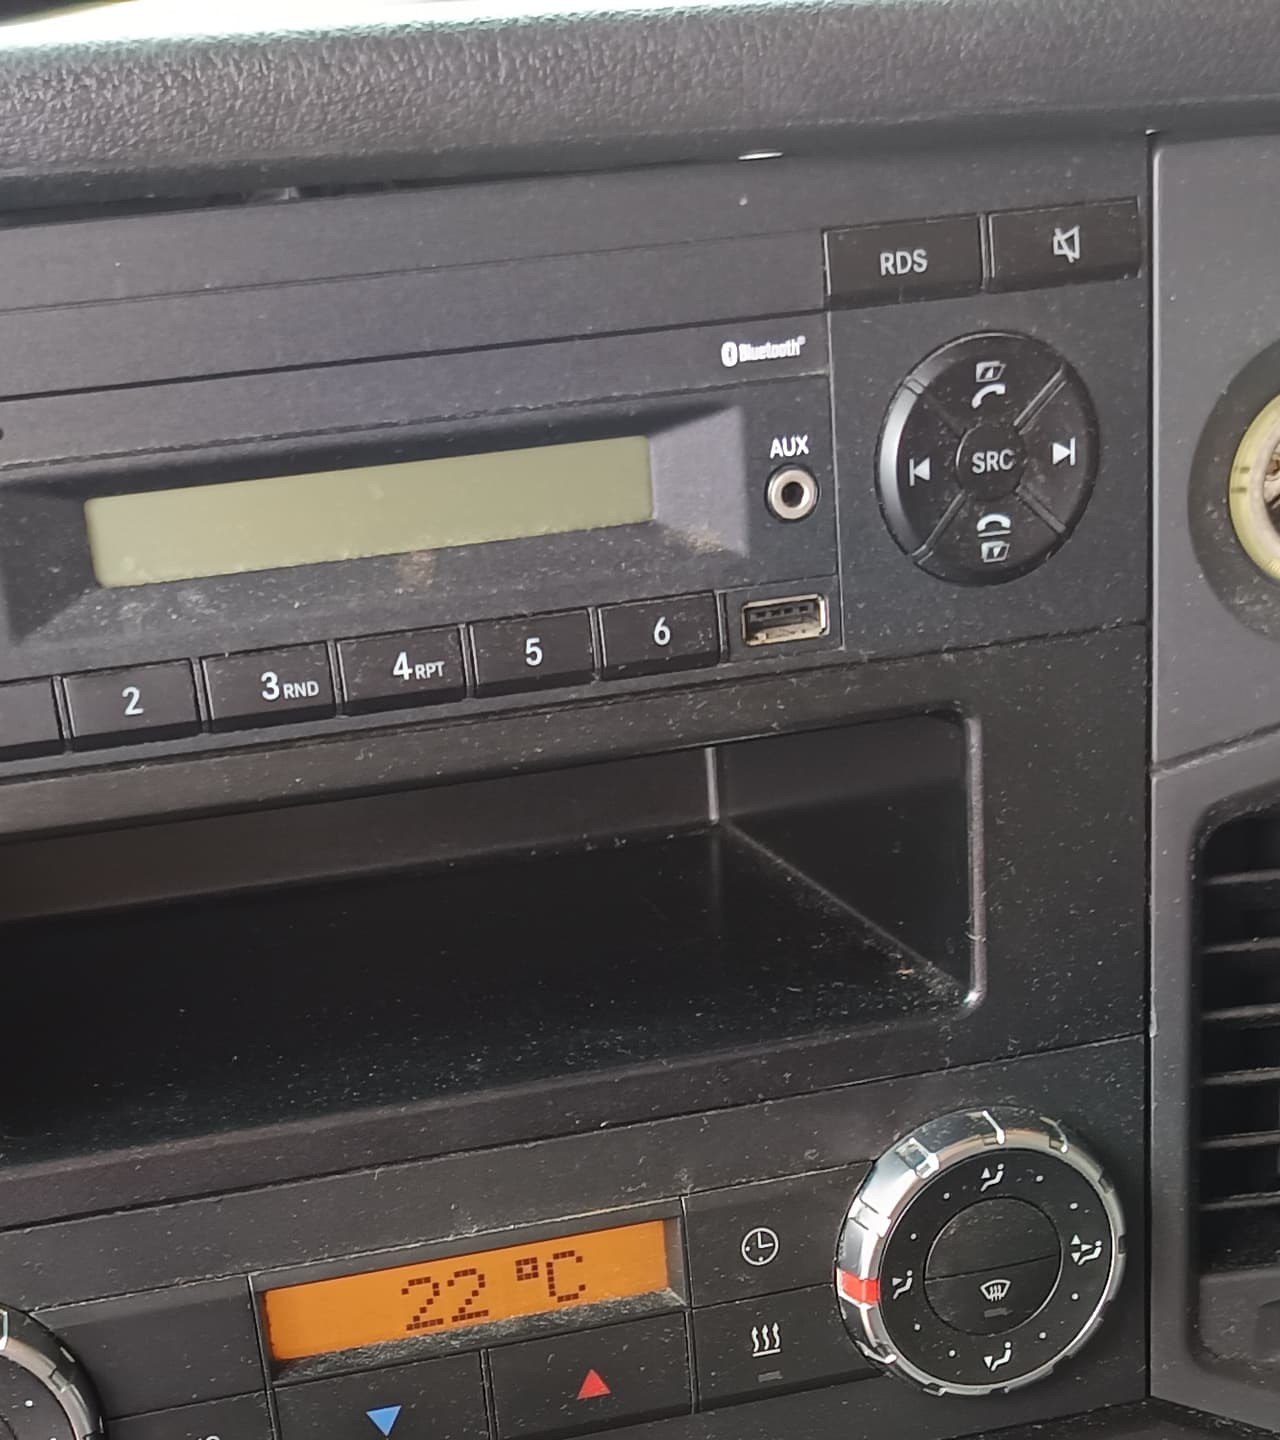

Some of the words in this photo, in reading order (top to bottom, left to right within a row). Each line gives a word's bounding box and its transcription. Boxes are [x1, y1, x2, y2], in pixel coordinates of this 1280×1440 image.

[880, 249, 927, 276] RDS
[770, 435, 809, 458] AUX
[972, 449, 1015, 474] SRC
[653, 617, 671, 646] 6
[525, 638, 543, 666] 5
[122, 687, 143, 716] 2
[402, 1268, 489, 1331] 22
